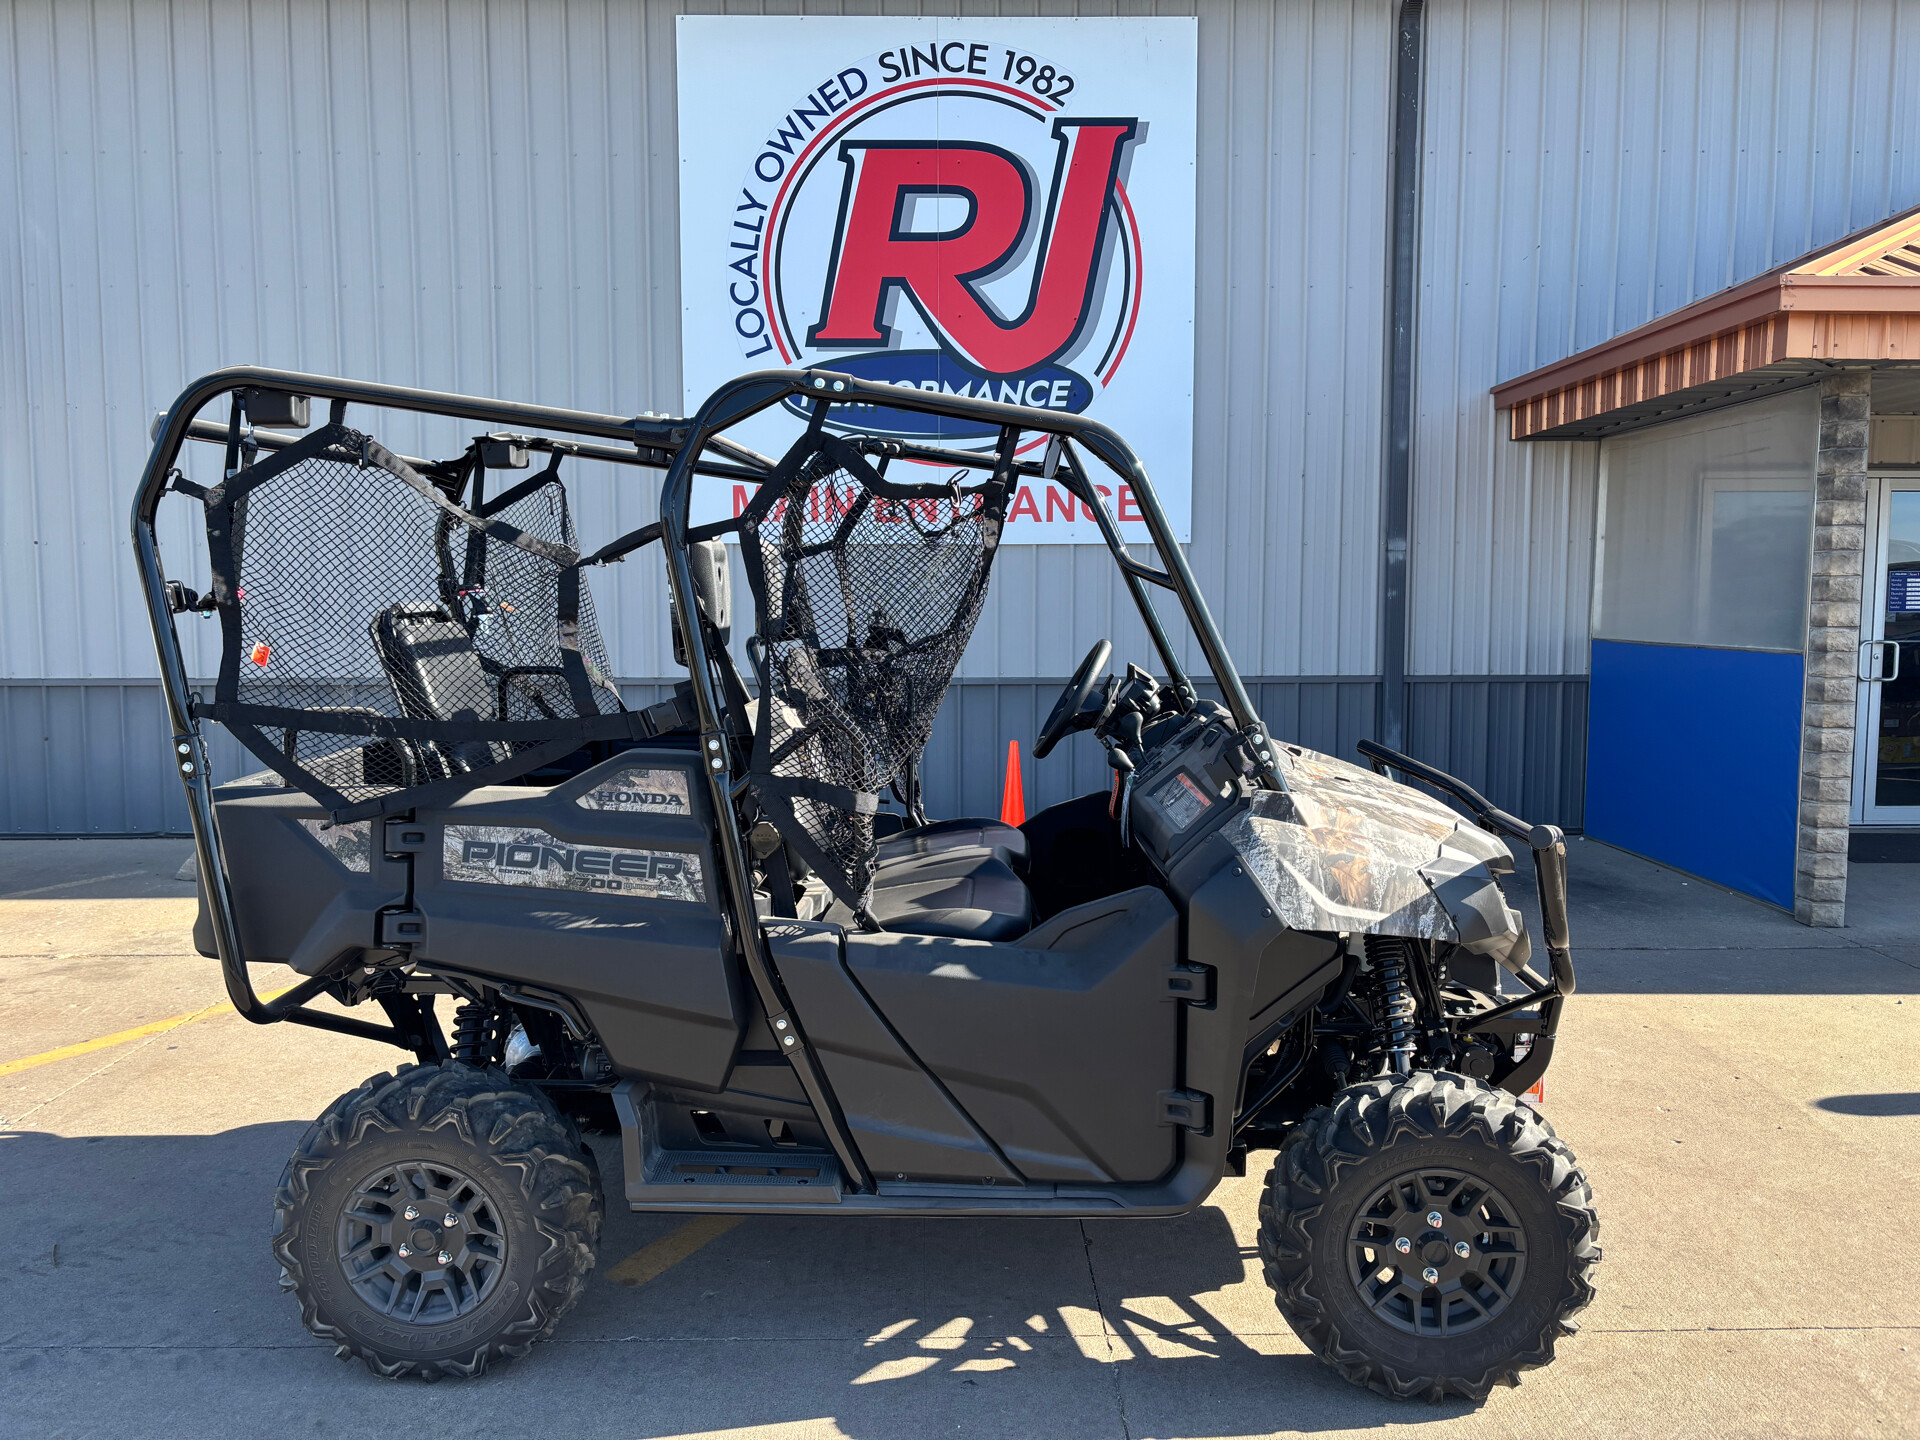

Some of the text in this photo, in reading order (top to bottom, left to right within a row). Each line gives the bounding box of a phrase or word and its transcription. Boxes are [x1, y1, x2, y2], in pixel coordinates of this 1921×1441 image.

[728, 42, 1075, 359] LOCALLY OWNED SINCE 1982
[805, 117, 1139, 373] RJ
[801, 379, 1072, 408] RMANCE
[874, 485, 1146, 523] ENANCE
[595, 790, 684, 806] HONDA
[462, 840, 684, 881] PIONEER
[498, 868, 532, 876] EDITION
[574, 876, 623, 890] 700
